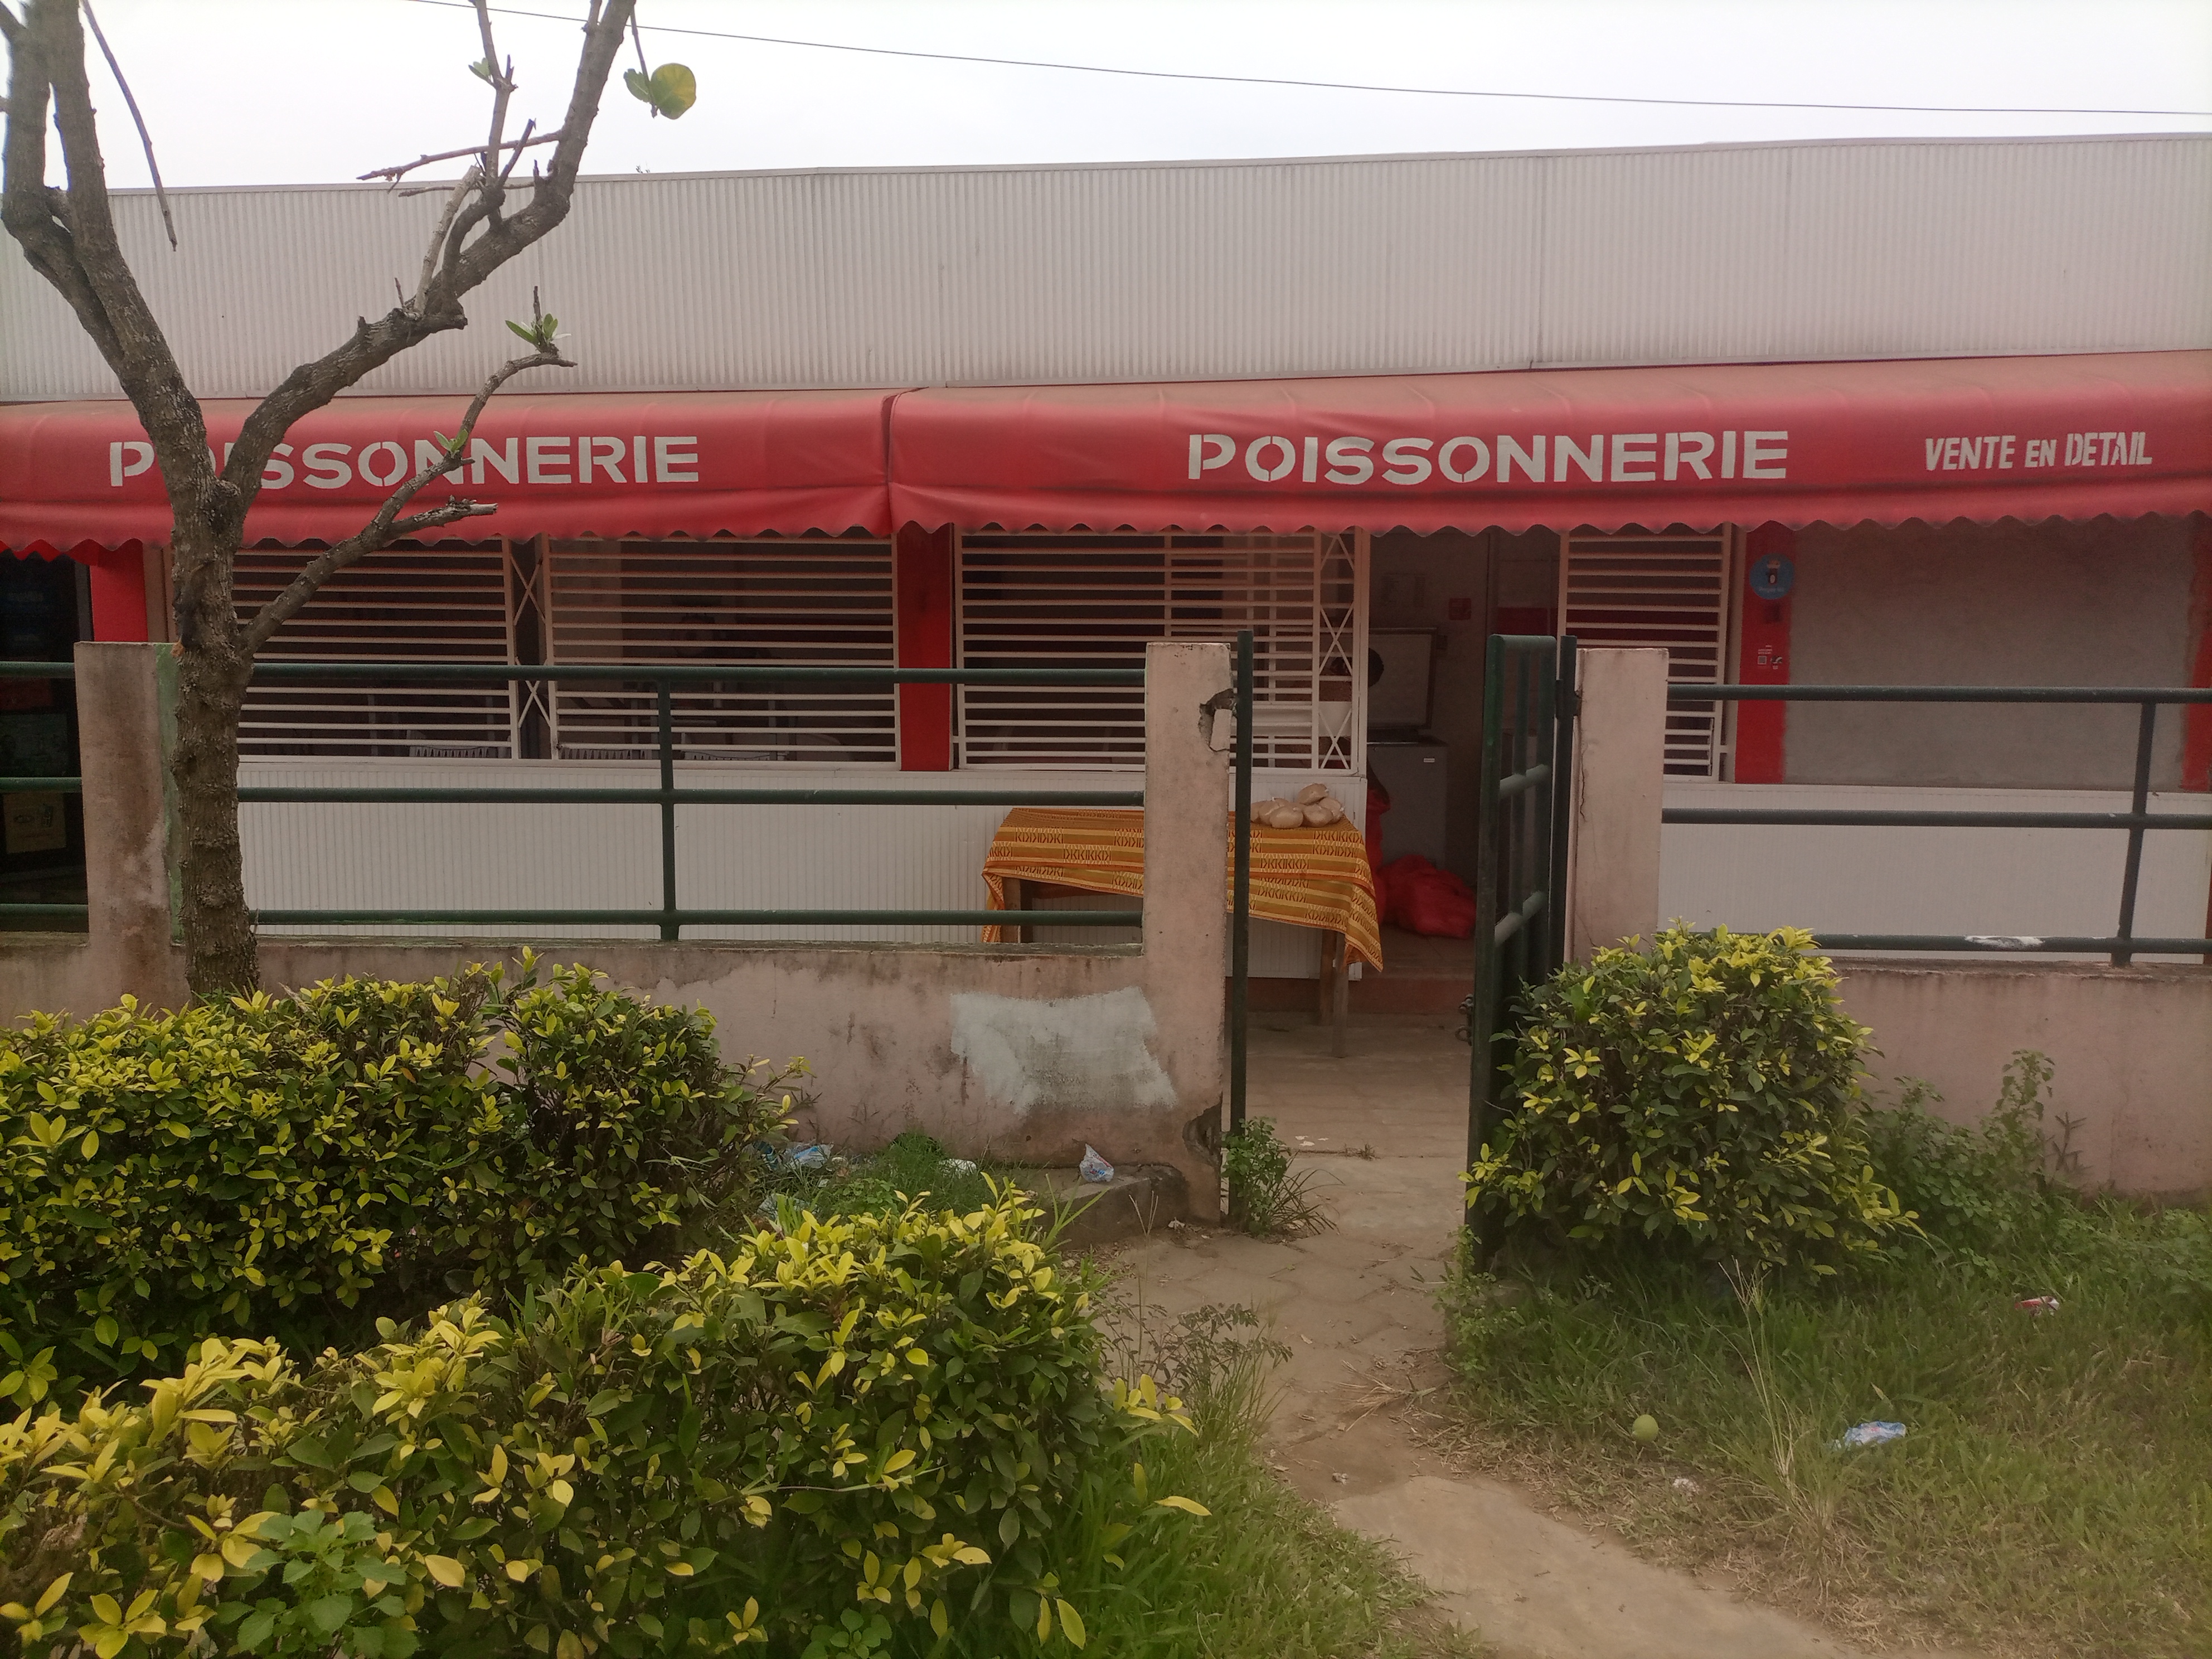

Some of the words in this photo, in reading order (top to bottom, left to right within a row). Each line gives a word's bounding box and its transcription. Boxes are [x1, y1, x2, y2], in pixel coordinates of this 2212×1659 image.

[109, 435, 699, 489] PSSONNERIE
[1187, 430, 1788, 485] POISSONNERIE
[1925, 435, 2016, 470] VENTE
[2024, 439, 2058, 468] EN
[2064, 431, 2153, 467] DETAIL
